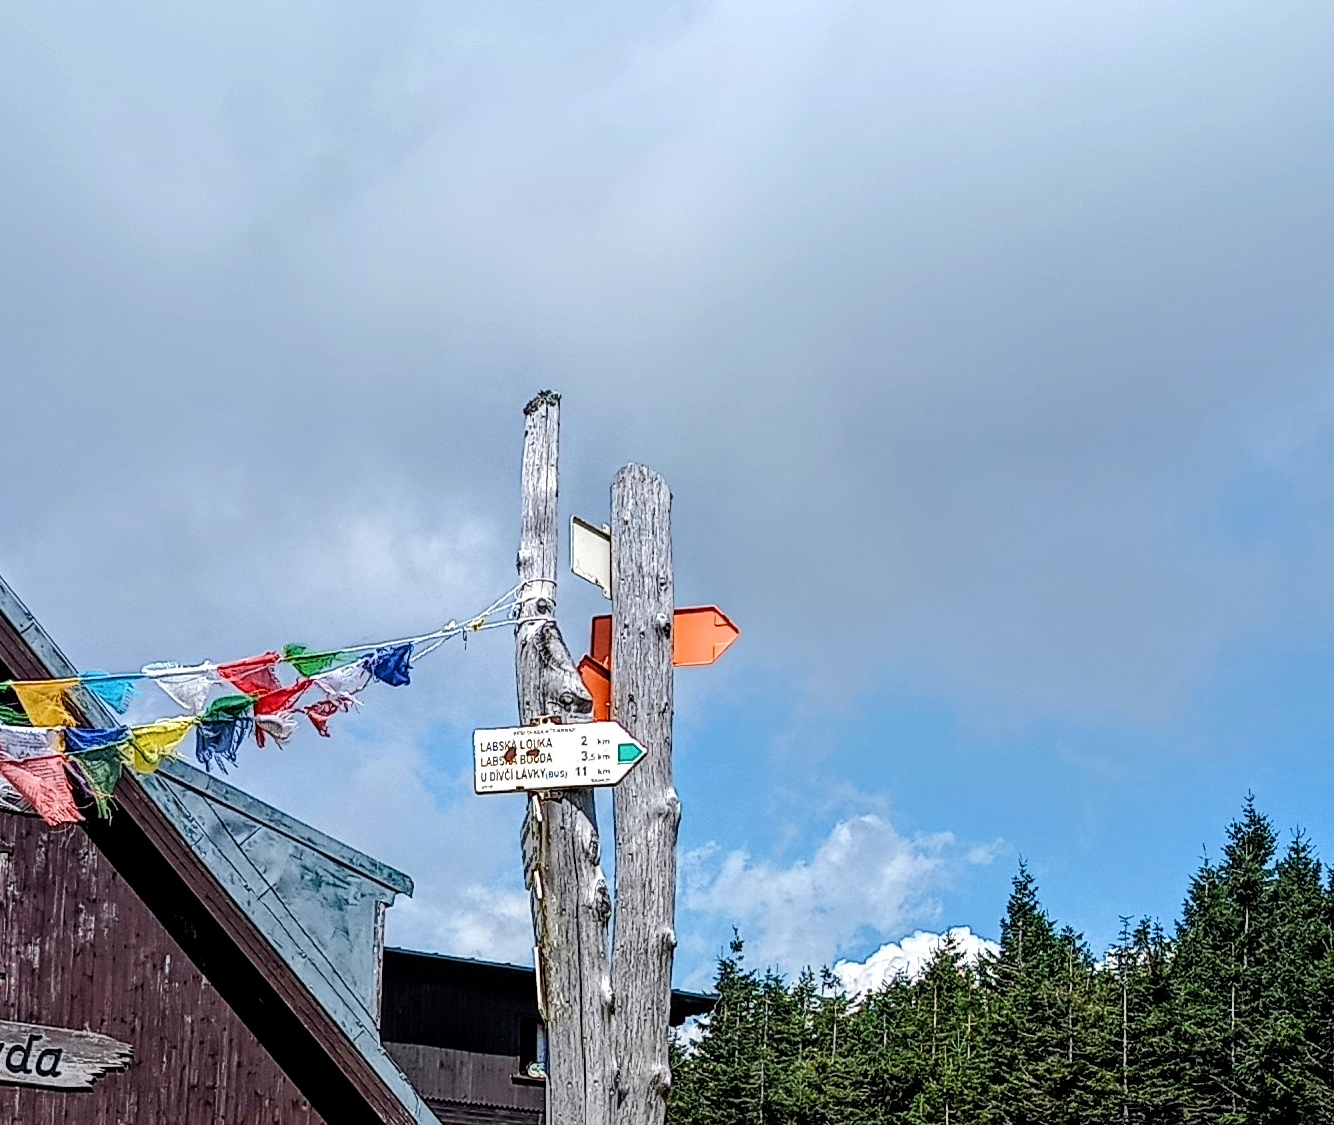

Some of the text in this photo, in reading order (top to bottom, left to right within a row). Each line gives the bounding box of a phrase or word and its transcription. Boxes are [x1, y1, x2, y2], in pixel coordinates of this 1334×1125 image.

[520, 737, 553, 750] LOUKA
[580, 736, 588, 746] 2
[597, 753, 611, 761] km
[480, 772, 487, 782] U
[575, 766, 587, 777] 11
[597, 768, 611, 776] km
